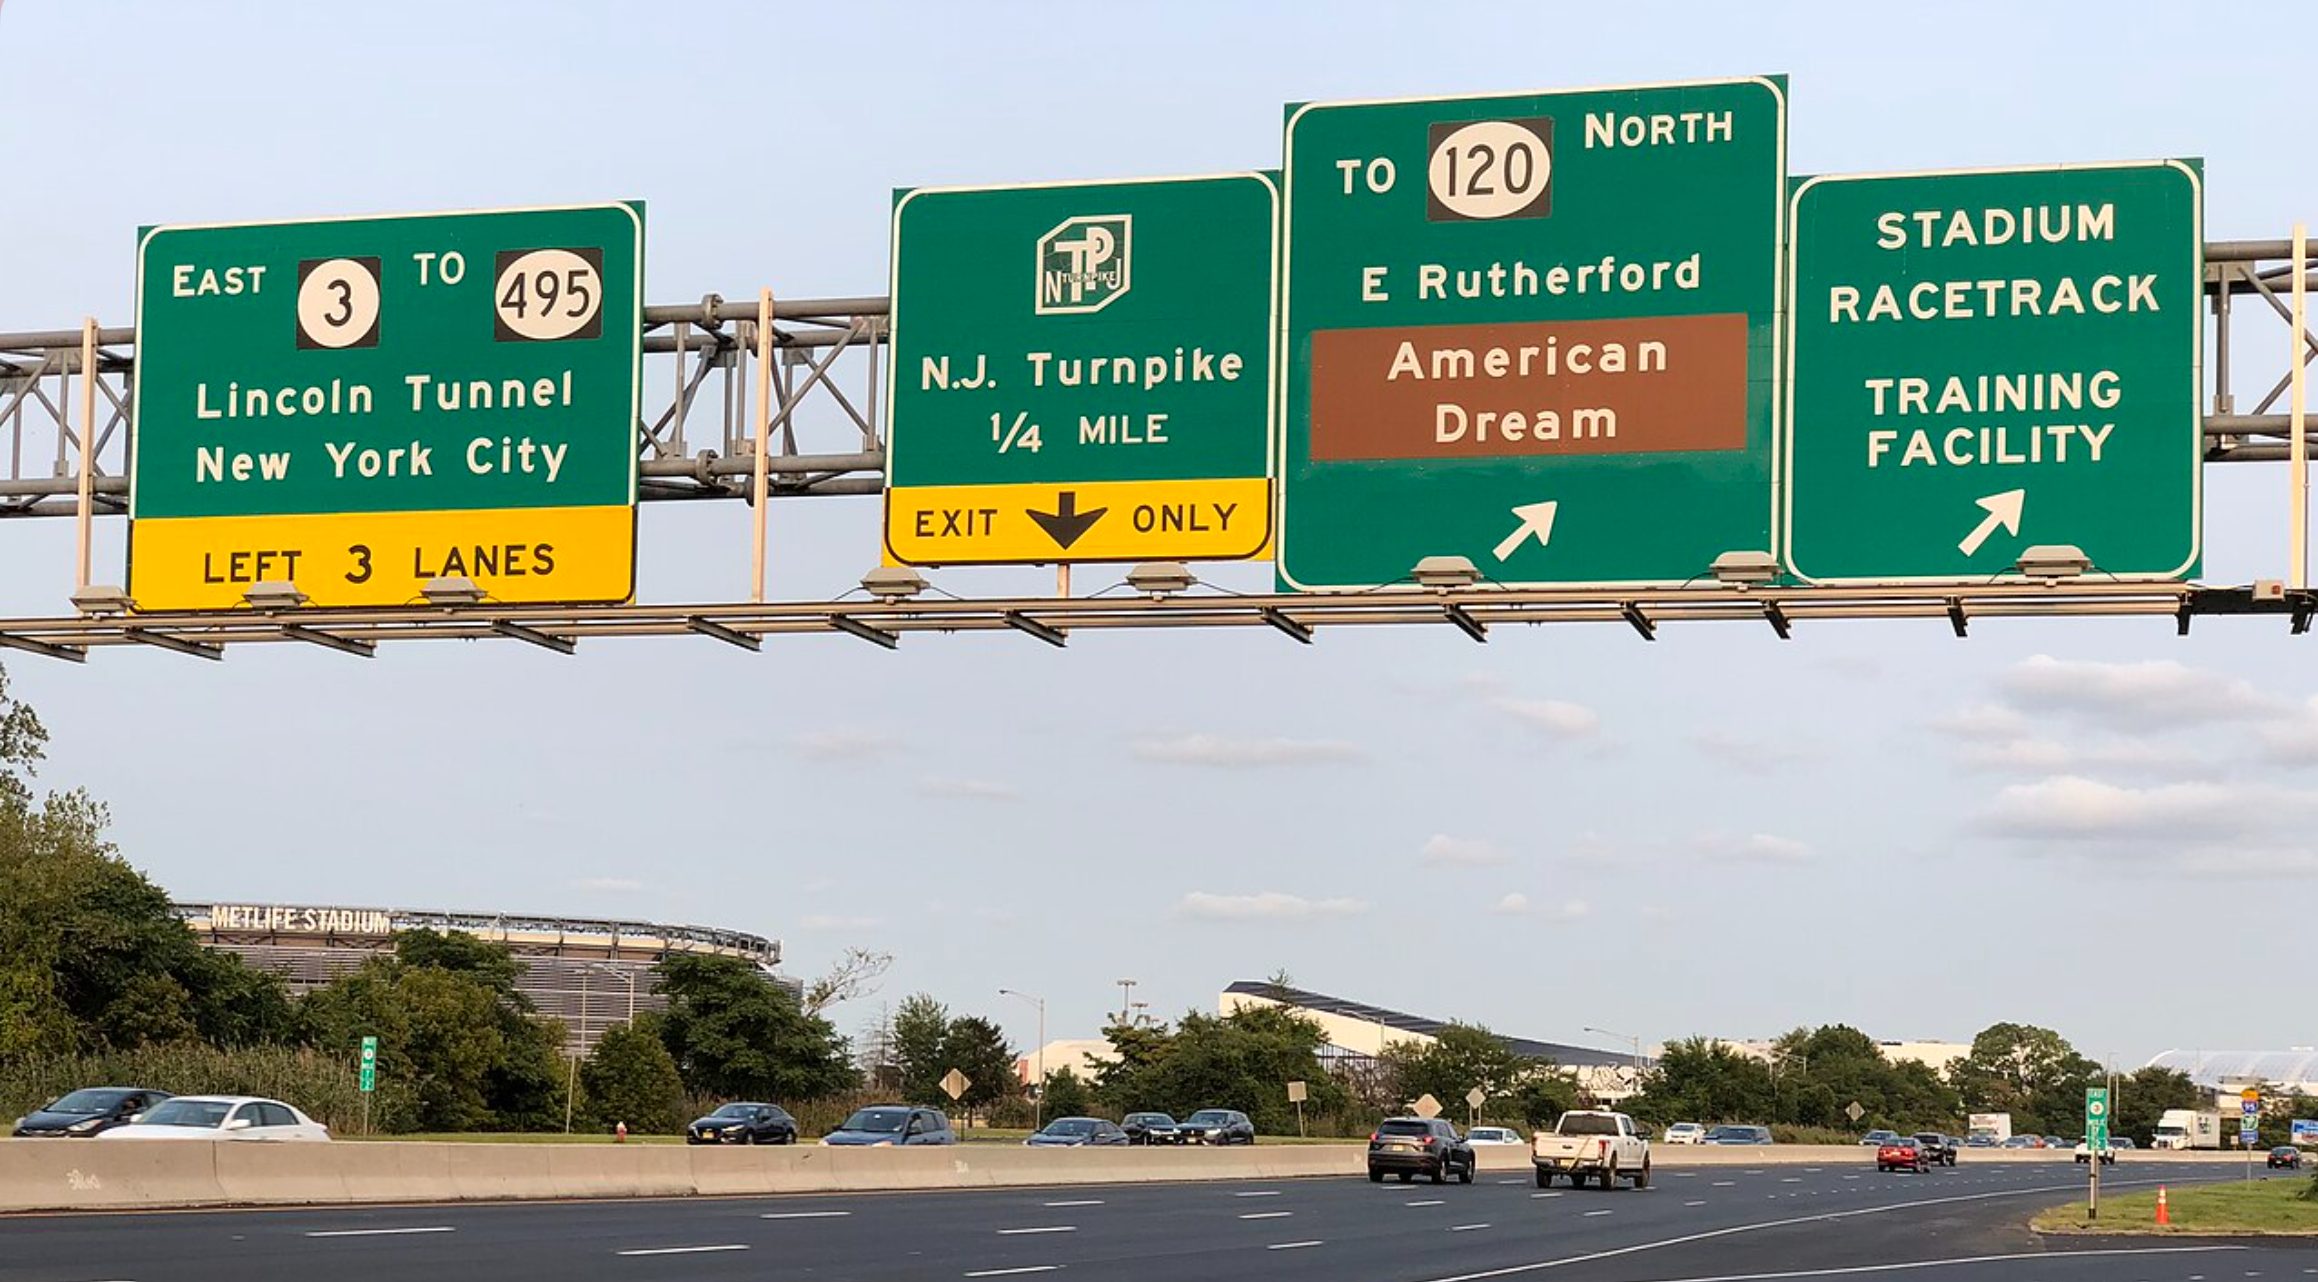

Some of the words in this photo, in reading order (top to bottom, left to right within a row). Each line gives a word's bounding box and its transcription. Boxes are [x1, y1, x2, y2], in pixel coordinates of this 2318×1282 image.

[1585, 111, 1733, 149] NORTH
[1336, 157, 1396, 195] TO
[1446, 141, 1534, 197] 120
[1876, 203, 2115, 250] STADIUM
[173, 264, 267, 298] EAST
[323, 278, 352, 327] 3
[413, 250, 466, 286] TO
[500, 268, 590, 319] 495
[1362, 266, 1390, 302] E
[1418, 252, 1701, 300] Rutherford
[1829, 273, 2161, 323] RACETRACK
[922, 354, 998, 391] N.J.
[1027, 346, 1244, 391] Turnpike
[1387, 335, 1668, 381] American
[196, 378, 373, 419] Lincoln
[405, 369, 573, 411] Tunnel
[1864, 370, 2122, 416] TRAINING
[1078, 413, 1169, 445] MILE
[1435, 402, 1617, 443] Dream
[1867, 422, 2115, 468] FACILITY
[196, 445, 291, 483] New
[325, 437, 433, 479] York
[466, 436, 568, 483] City
[915, 508, 999, 537] EXIT
[1133, 502, 1238, 533] ONLY
[204, 550, 302, 583] LEFT
[344, 544, 373, 584] 3
[414, 542, 555, 578] LANES
[212, 905, 296, 930] METLIFE
[304, 908, 391, 934] STADIUM
